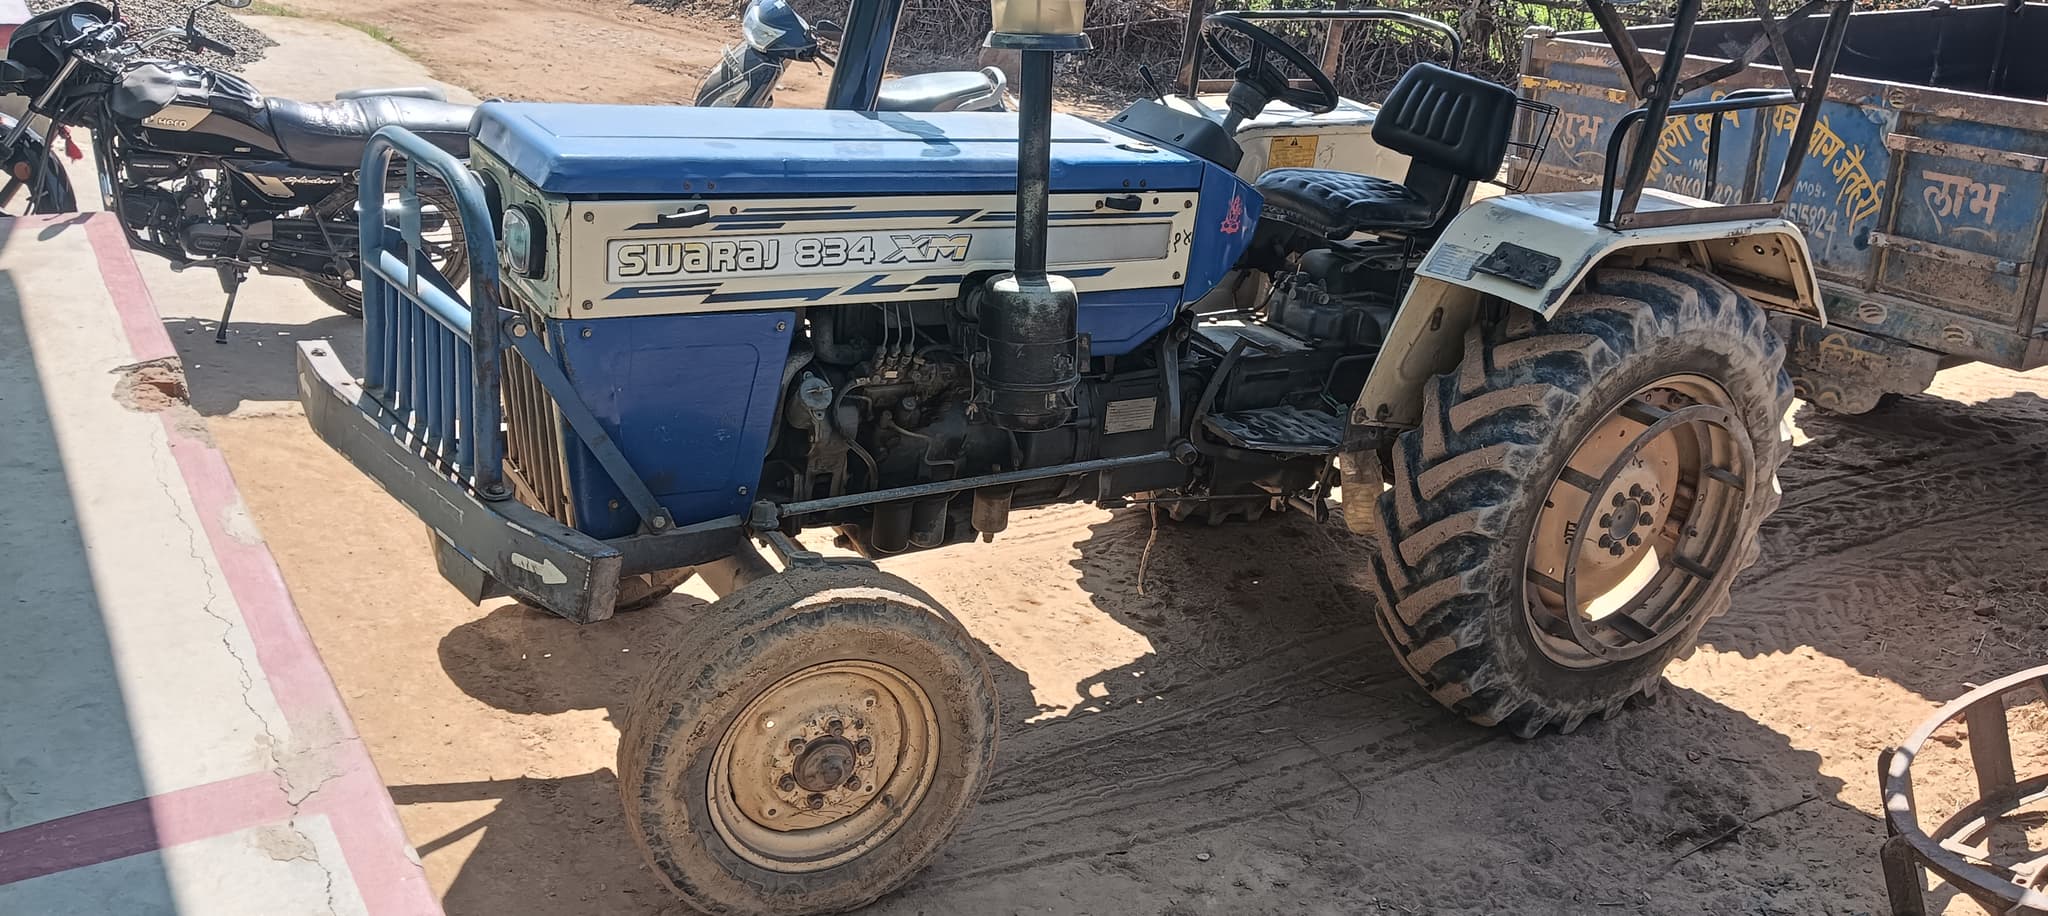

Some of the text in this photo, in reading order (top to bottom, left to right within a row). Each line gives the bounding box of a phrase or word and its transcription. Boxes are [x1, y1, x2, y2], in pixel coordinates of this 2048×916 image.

[158, 117, 187, 128] Hero
[1923, 170, 2006, 234] लाभ
[795, 236, 876, 268] 834
[880, 234, 972, 264] XM
